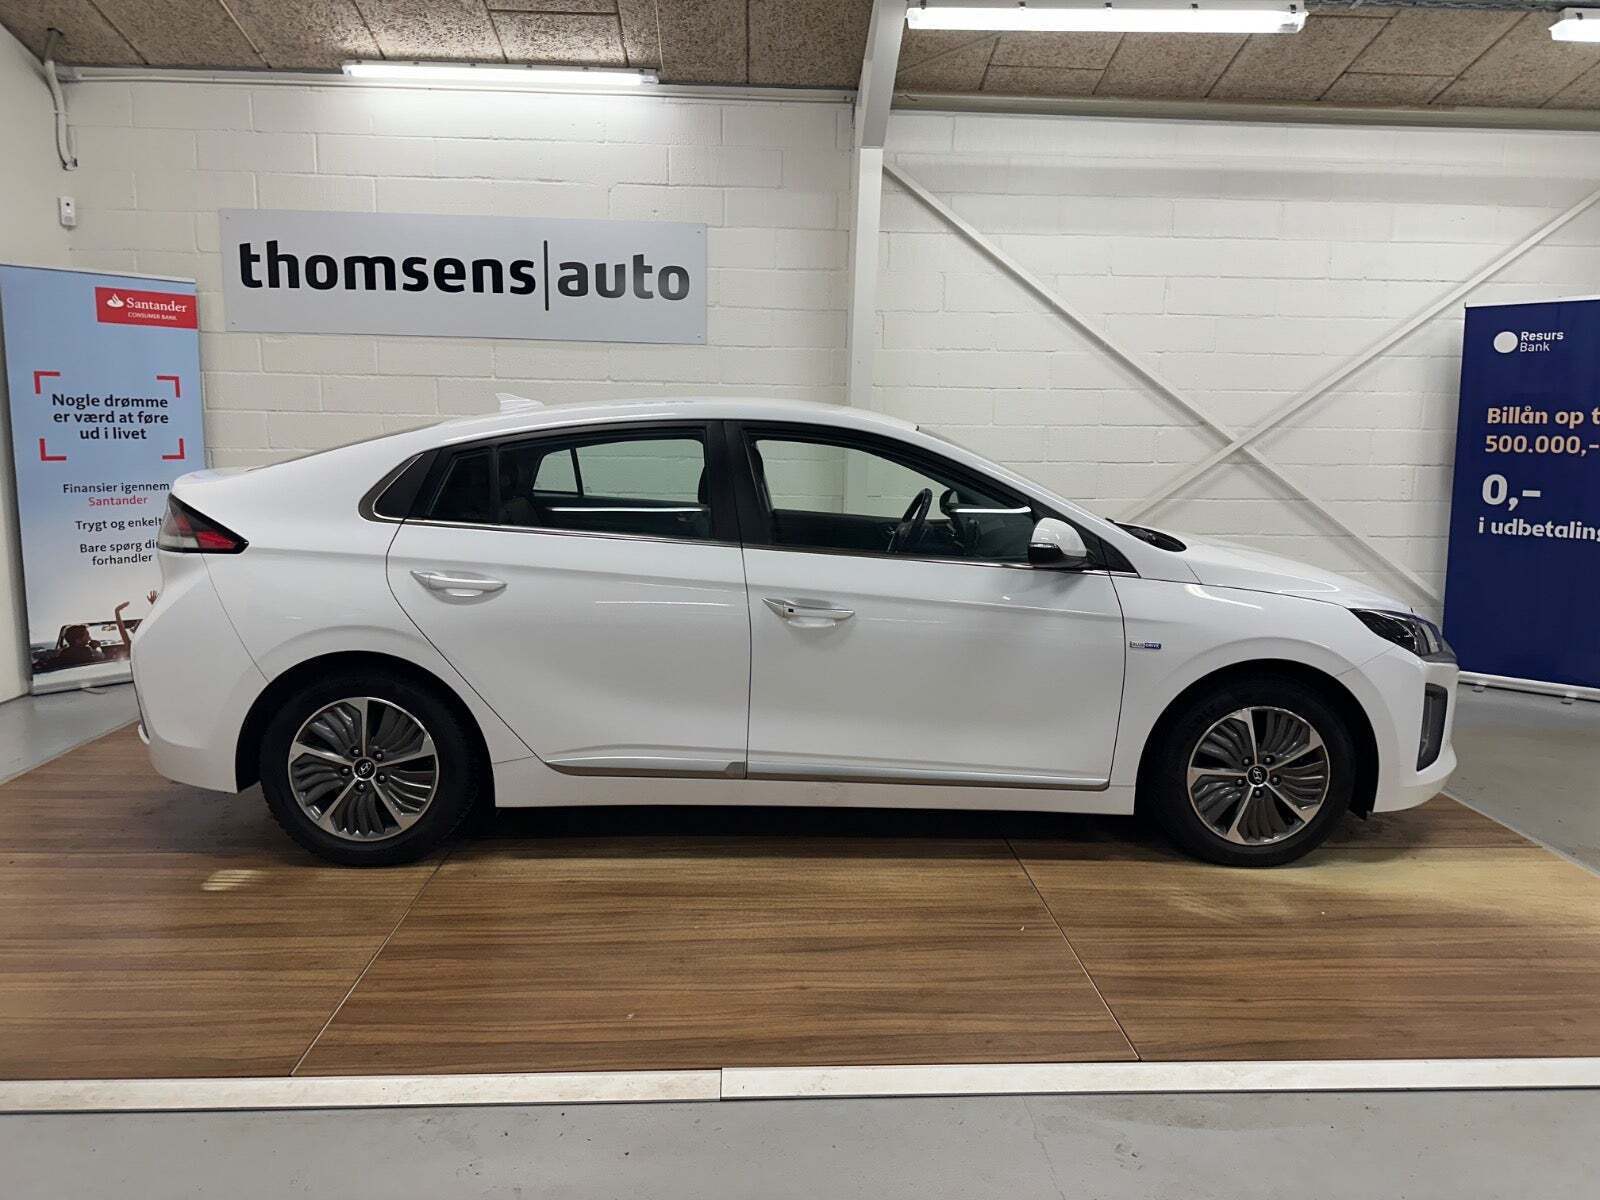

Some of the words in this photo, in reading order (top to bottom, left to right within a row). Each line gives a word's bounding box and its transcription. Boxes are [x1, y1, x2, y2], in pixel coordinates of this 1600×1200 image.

[126, 297, 187, 313] Santander
[1520, 331, 1564, 341] Resurs
[1520, 342, 1550, 352] Bank
[52, 393, 100, 411] Nogle
[104, 394, 168, 408] drømme
[53, 412, 70, 423] er
[74, 410, 115, 423] værd
[119, 412, 134, 424] at
[138, 411, 169, 424] føre
[1487, 406, 1548, 424] Billån
[1555, 410, 1584, 429] op
[80, 427, 99, 439] ud
[104, 427, 108, 439] i
[113, 427, 147, 440] livet
[63, 482, 117, 494] Finansier
[121, 482, 170, 495] igennem
[88, 495, 148, 506] Santander
[75, 519, 107, 532] Trygt
[110, 521, 125, 531] og
[128, 516, 162, 527] enkelt
[1478, 517, 1485, 534] i
[80, 543, 107, 553] Bare
[109, 541, 142, 553] spørg
[92, 553, 152, 566] forhandler
